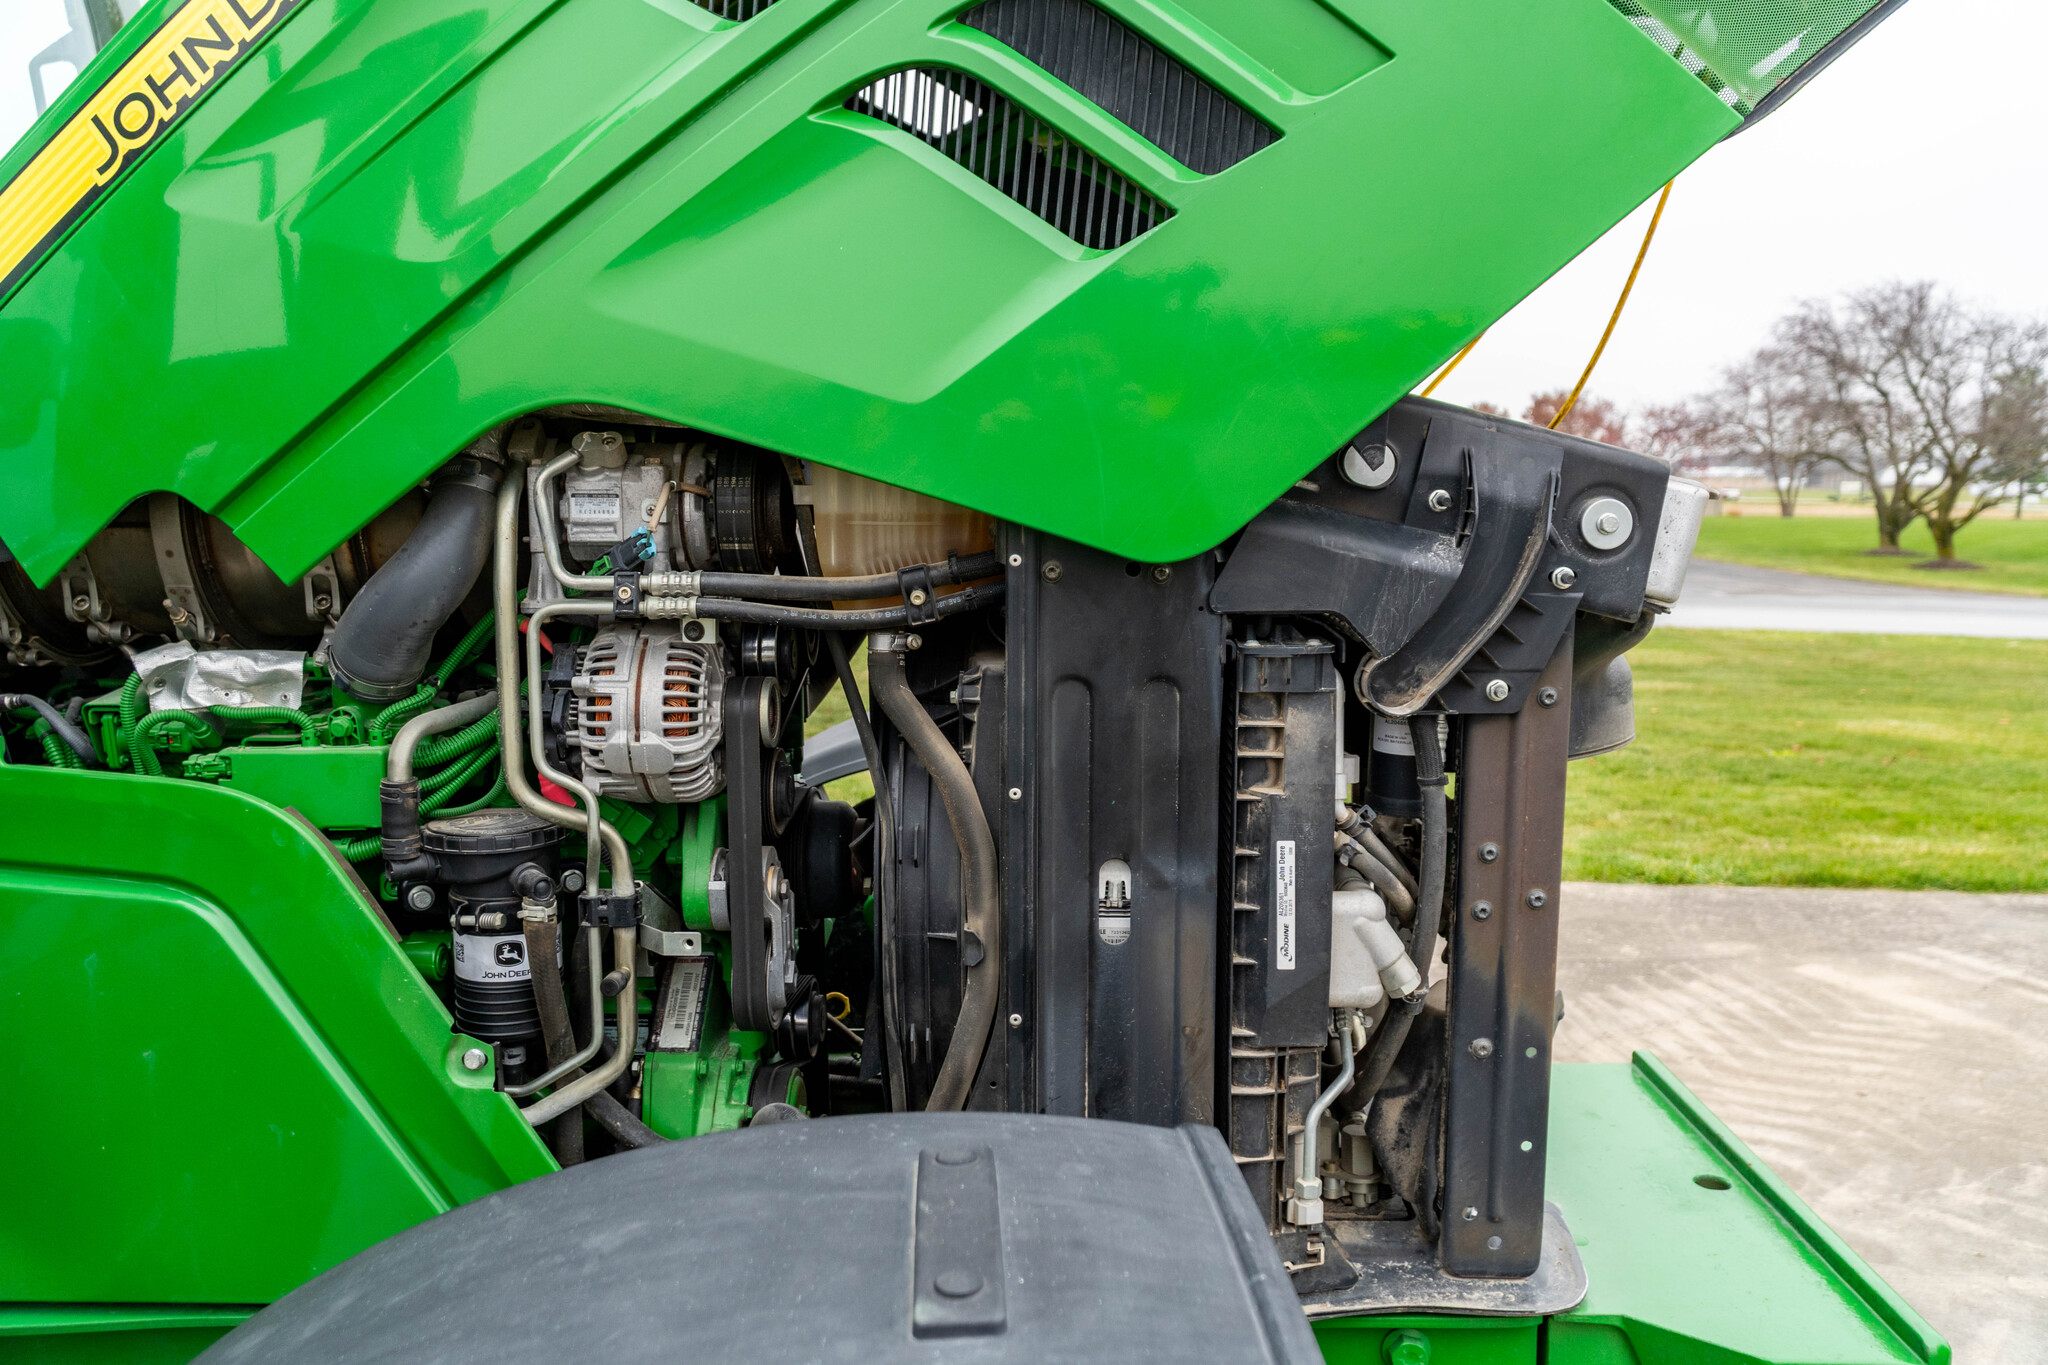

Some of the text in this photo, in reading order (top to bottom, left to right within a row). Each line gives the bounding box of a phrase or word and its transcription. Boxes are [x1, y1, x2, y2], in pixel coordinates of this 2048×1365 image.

[90, 14, 236, 177] JOHN
[948, 597, 962, 606] SAE
[482, 970, 506, 978] JOHN
